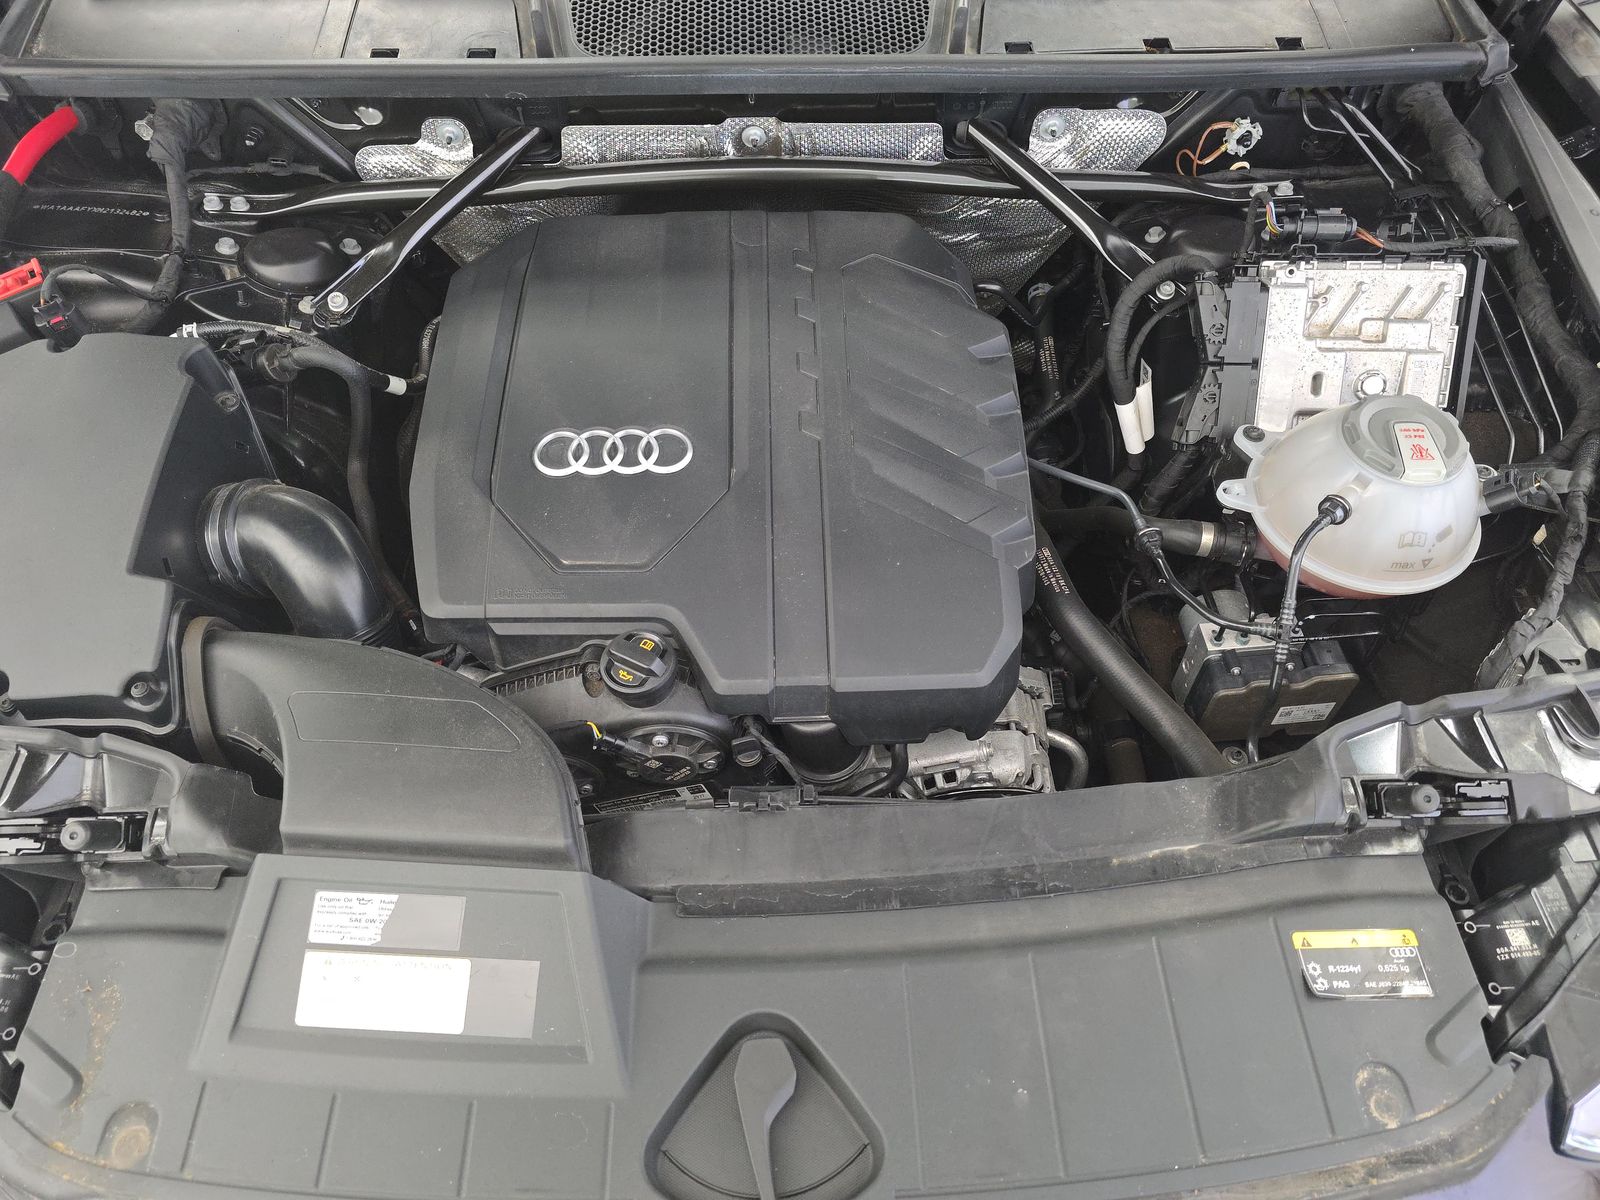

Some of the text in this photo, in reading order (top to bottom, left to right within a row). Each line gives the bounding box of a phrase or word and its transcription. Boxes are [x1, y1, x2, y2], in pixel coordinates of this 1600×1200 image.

[1390, 560, 1416, 570] max
[1399, 964, 1410, 973] kg
[1332, 980, 1351, 989] PAG
